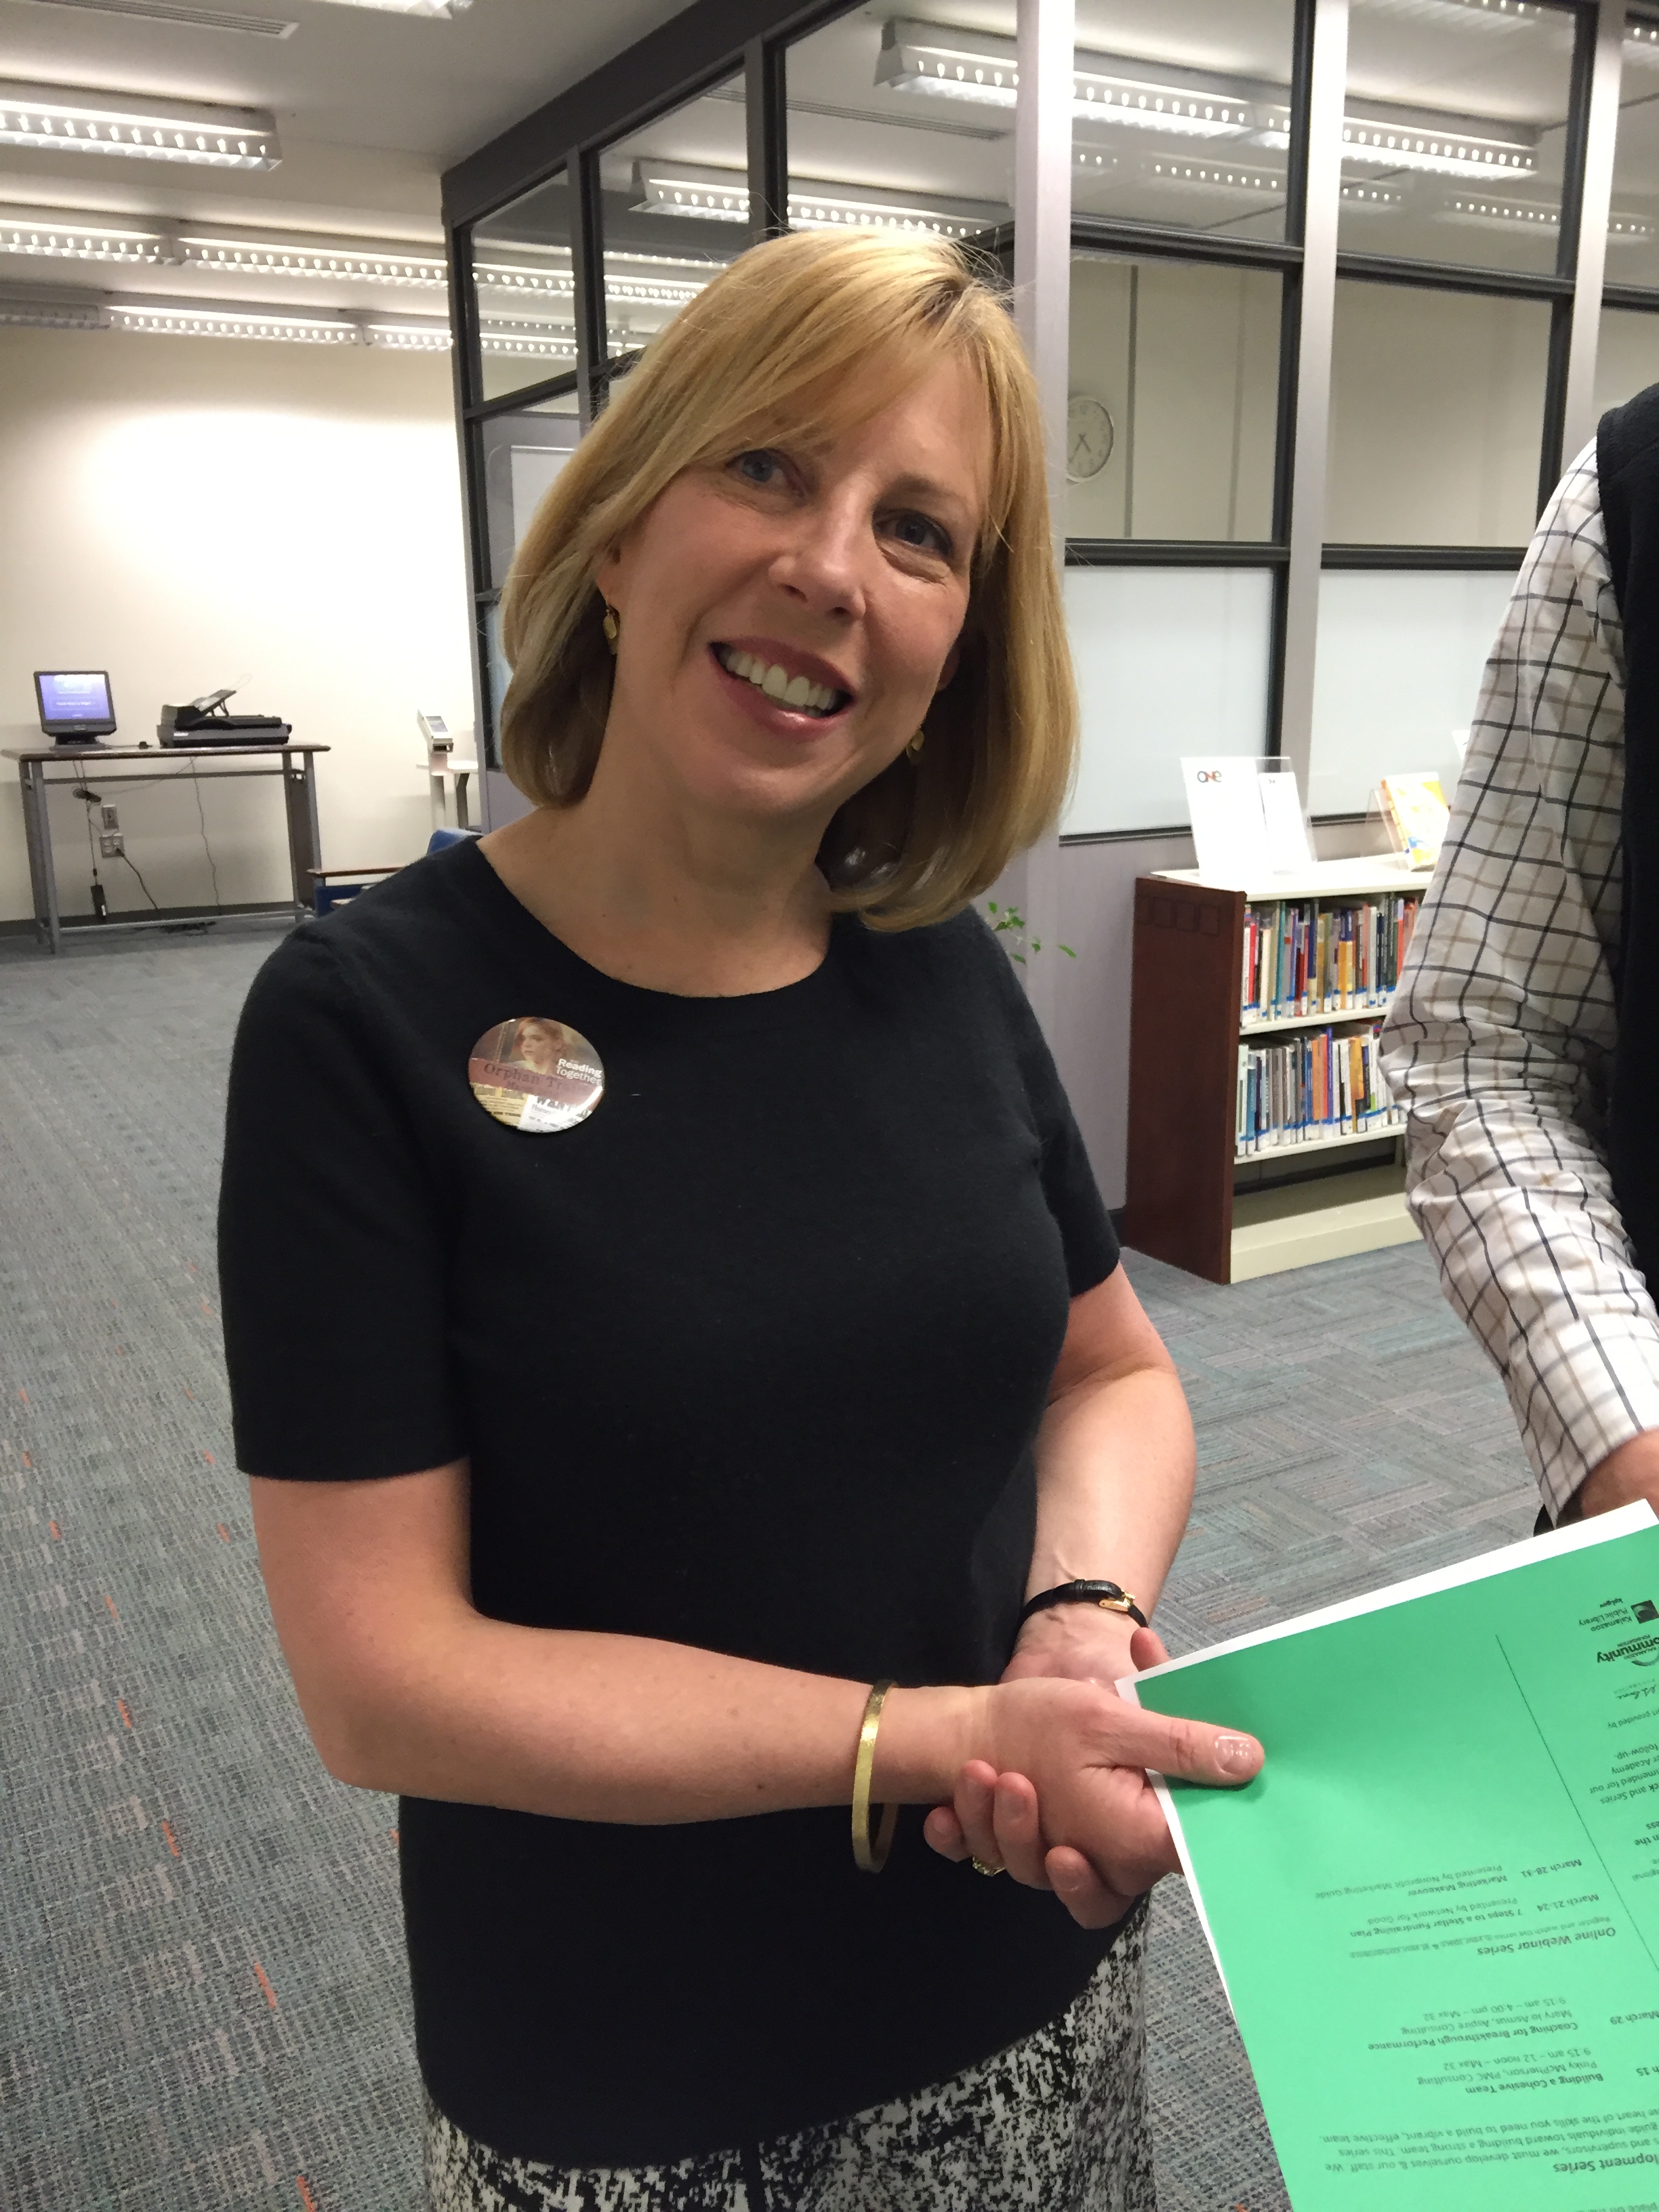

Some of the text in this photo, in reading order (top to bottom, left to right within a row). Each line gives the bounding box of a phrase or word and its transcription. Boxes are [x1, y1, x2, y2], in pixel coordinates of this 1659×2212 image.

[558, 1058, 602, 1078] Reading
[484, 1063, 541, 1085] Orphan
[556, 1065, 602, 1086] Together
[1579, 1607, 1629, 1626] Public Library
[1591, 1616, 1633, 1632] Kalamazoo
[1618, 1711, 1651, 1727] provided
[1612, 1758, 1650, 1774] Academy
[1589, 1785, 1604, 1794] our
[1607, 1780, 1620, 1789] for
[1629, 1786, 1647, 1798] and
[1600, 1792, 1628, 1805] Series
[1634, 1837, 1652, 1845] the
[1550, 1859, 1582, 1872] March
[1455, 1864, 1502, 1879] Presented
[1395, 1876, 1440, 1888] Nonprofit
[1408, 1875, 1508, 1896] Marketing Makeover
[1315, 1889, 1343, 1899] Guide
[1343, 1883, 1393, 1894] Marketing
[1469, 1897, 1518, 1911] Presented
[1536, 1893, 1599, 1912] March 21-24
[1412, 1908, 1454, 1920] Network
[1487, 1910, 1515, 1919] Steps
[1367, 1916, 1394, 1925] Good
[1433, 1917, 1465, 1927] Stellar
[1373, 1923, 1431, 1935] Fundraising
[1477, 1927, 1616, 1956] Online Webinar Series
[1422, 2013, 1435, 2022] 32
[1438, 2010, 1460, 2018] Max
[1544, 2010, 1572, 2018] Mary
[1610, 2010, 1659, 2025] March 29
[1400, 2023, 1455, 2034] Consulting
[1458, 2020, 1490, 2029] Aspire
[1368, 2022, 1578, 2050] Coaching for Breakthrough Performance
[1523, 2054, 1538, 2063] 12
[1547, 2050, 1565, 2058] am
[1458, 2060, 1483, 2068] Max
[1493, 2056, 1521, 2064] noon
[1443, 2062, 1456, 2071] 32
[1636, 2067, 1650, 2076] 15
[1416, 2061, 1597, 2085] Pinky McPherson, PMC Consulting
[1558, 2073, 1603, 2085] Building
[1465, 2085, 1498, 2093] Team
[1498, 2080, 1548, 2091] Cohesive
[1582, 2116, 1601, 2125] the
[1603, 2114, 1614, 2123] of
[1616, 2111, 1647, 2121] heart
[1499, 2123, 1528, 2134] need
[1530, 2119, 1551, 2129] you
[1553, 2118, 1580, 2129] skills
[1628, 2122, 1658, 2135] guide
[1455, 2127, 1483, 2137] build
[1567, 2128, 1626, 2142] individuals
[1353, 2133, 1399, 2144] effective
[1477, 2137, 1523, 2149] building
[1525, 2133, 1565, 2146] toward
[1630, 2139, 1651, 2149] and
[1338, 2148, 1370, 2158] series
[1372, 2148, 1396, 2157] This
[1430, 2143, 1467, 2152] strong
[1465, 2153, 1509, 2164] develop
[1511, 2150, 1540, 2160] must
[1325, 2164, 1345, 2172] We
[1377, 2161, 1396, 2169] our
[1410, 2157, 1462, 2169] ourselves
[1553, 2160, 1596, 2174] Series
